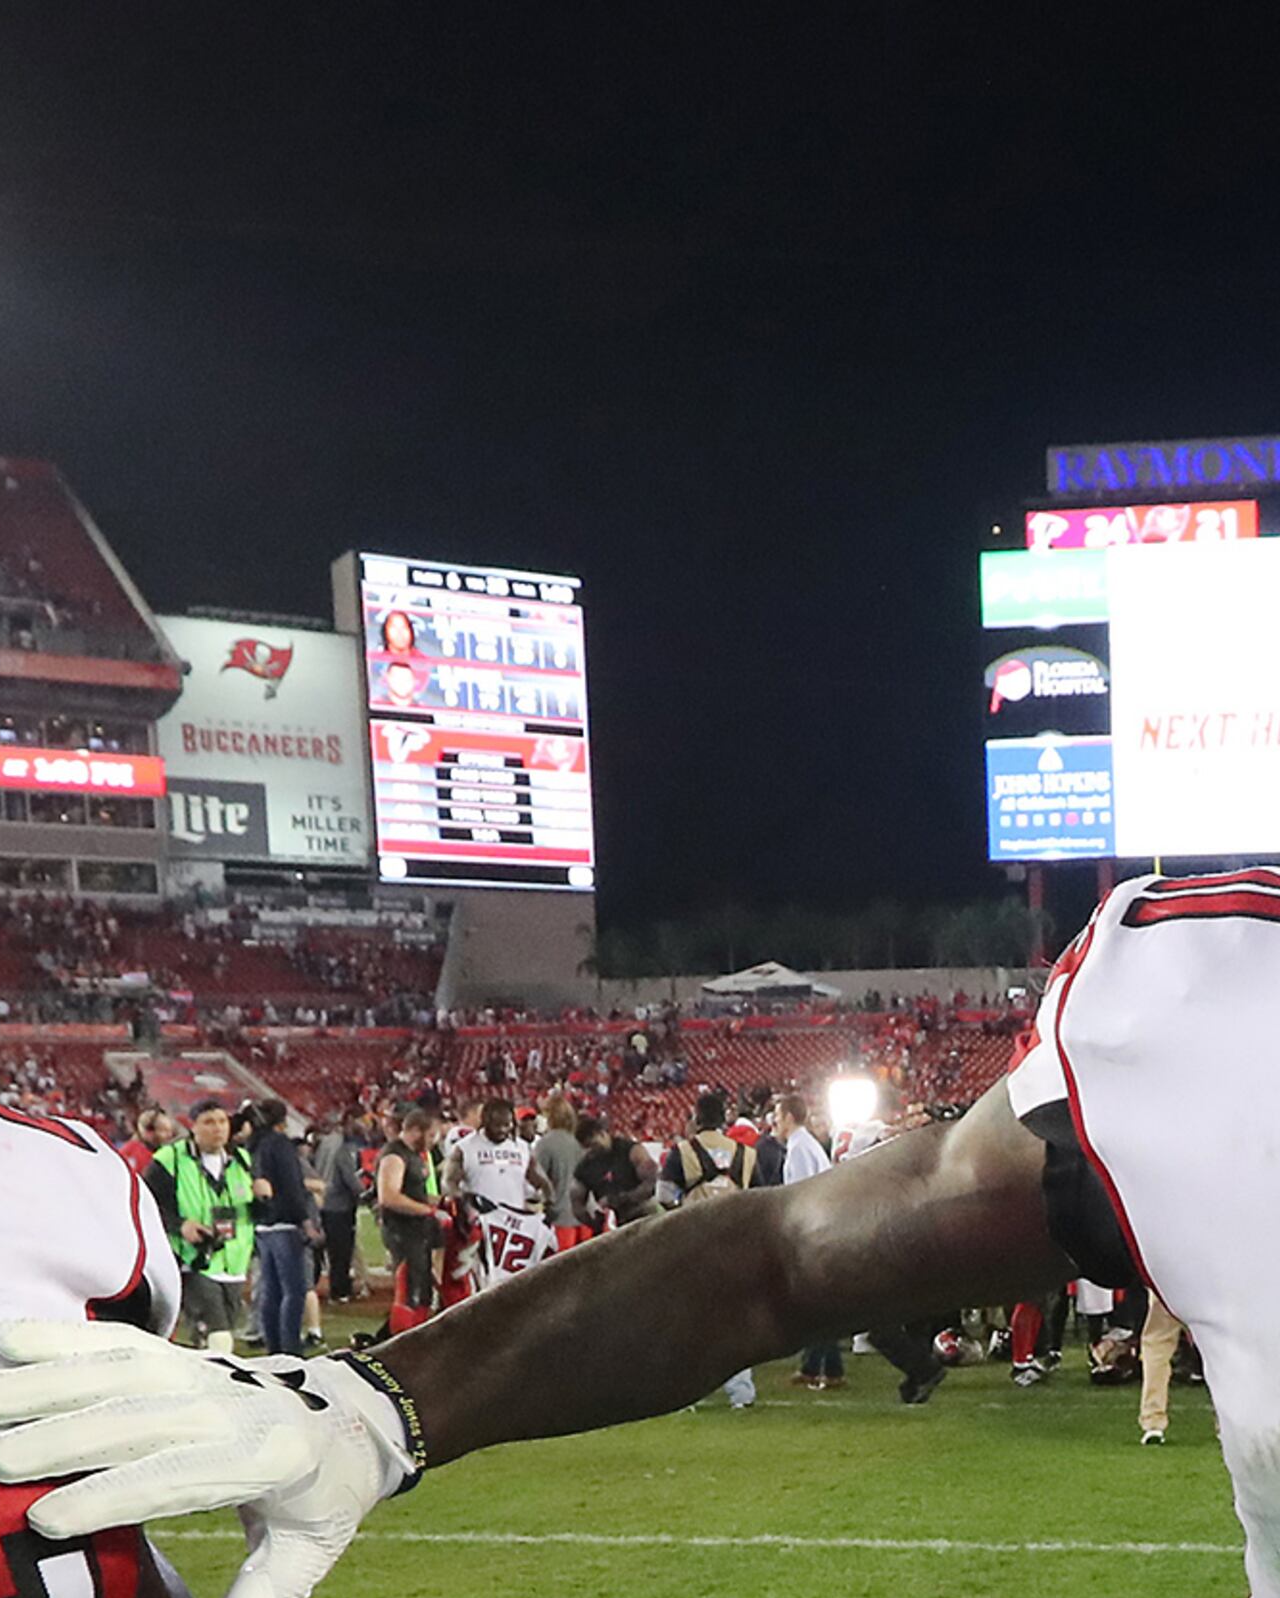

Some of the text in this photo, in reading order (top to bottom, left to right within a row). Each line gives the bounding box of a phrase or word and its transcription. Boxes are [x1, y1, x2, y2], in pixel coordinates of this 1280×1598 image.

[1140, 713, 1237, 750] NEXT
[181, 723, 344, 766] BUCCANEERS
[307, 794, 343, 811] IT'S
[168, 791, 250, 844] Lite
[291, 815, 362, 833] MILLER
[305, 834, 351, 851] TIME
[477, 1149, 523, 1161] FALCONS
